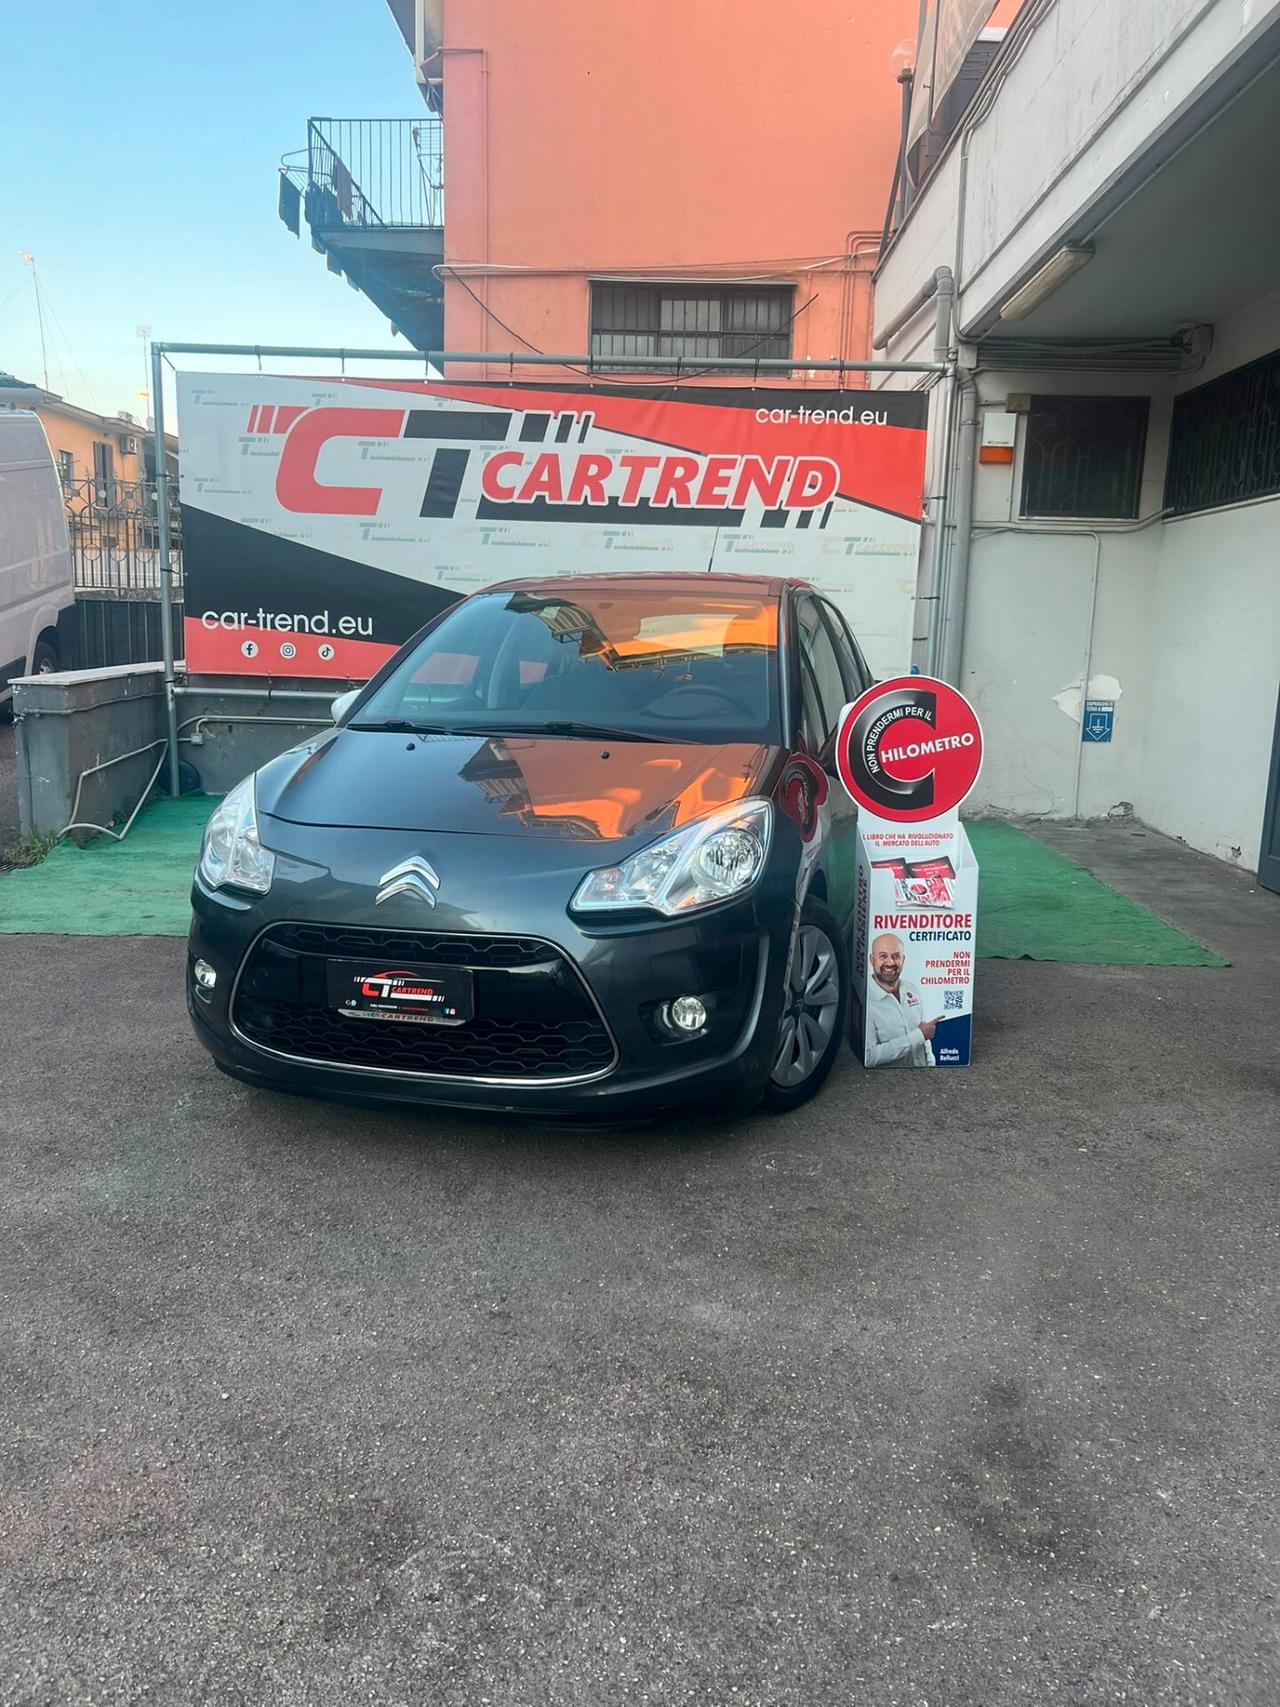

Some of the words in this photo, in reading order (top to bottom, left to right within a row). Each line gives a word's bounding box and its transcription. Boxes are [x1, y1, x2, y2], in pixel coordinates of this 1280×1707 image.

[755, 405, 889, 427] car-trend.eu
[481, 450, 840, 509] CARTREND
[201, 608, 374, 637] car-trend.eu
[905, 706, 923, 717] PER
[924, 710, 933, 722] IL
[866, 709, 904, 753] PRENDERMI
[866, 754, 879, 774] NON
[873, 914, 972, 930] RIVENDITORE
[909, 930, 972, 942] CERTIFICATO
[953, 951, 971, 960] NON
[925, 959, 971, 968] PRENDERMI
[947, 968, 962, 977] PER
[963, 968, 971, 976] IL
[920, 976, 970, 985] CHILOMETRO
[391, 986, 434, 995] CARTREND
[380, 1013, 434, 1022] CARTREND
[939, 1047, 959, 1056] Alfredo
[939, 1054, 960, 1062] Bellucci
